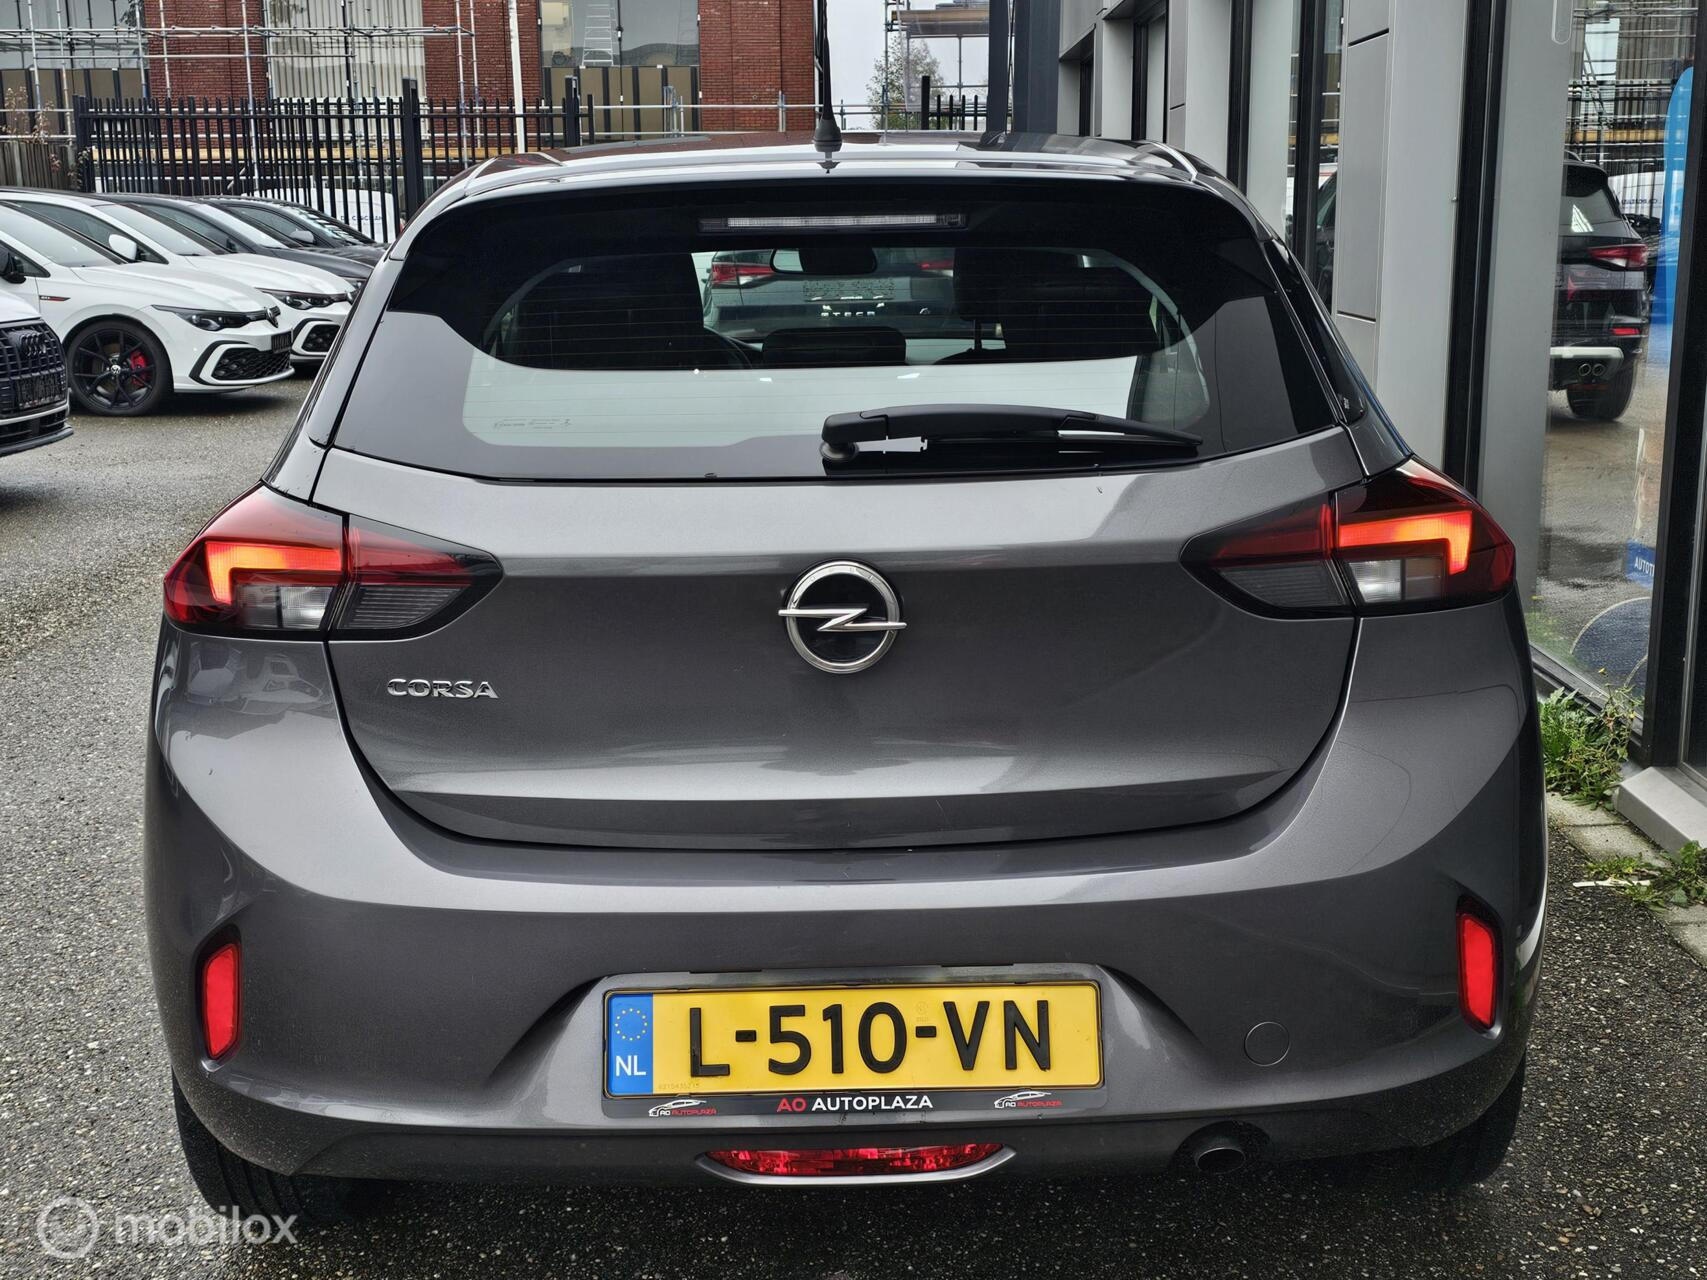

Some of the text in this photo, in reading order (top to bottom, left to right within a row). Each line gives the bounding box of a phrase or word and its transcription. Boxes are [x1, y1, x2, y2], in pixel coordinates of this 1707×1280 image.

[387, 678, 499, 699] CORSA
[689, 1000, 1051, 1077] L-510-VN
[615, 1055, 647, 1077] NL
[777, 1095, 934, 1113] AO AUTOPLAZA
